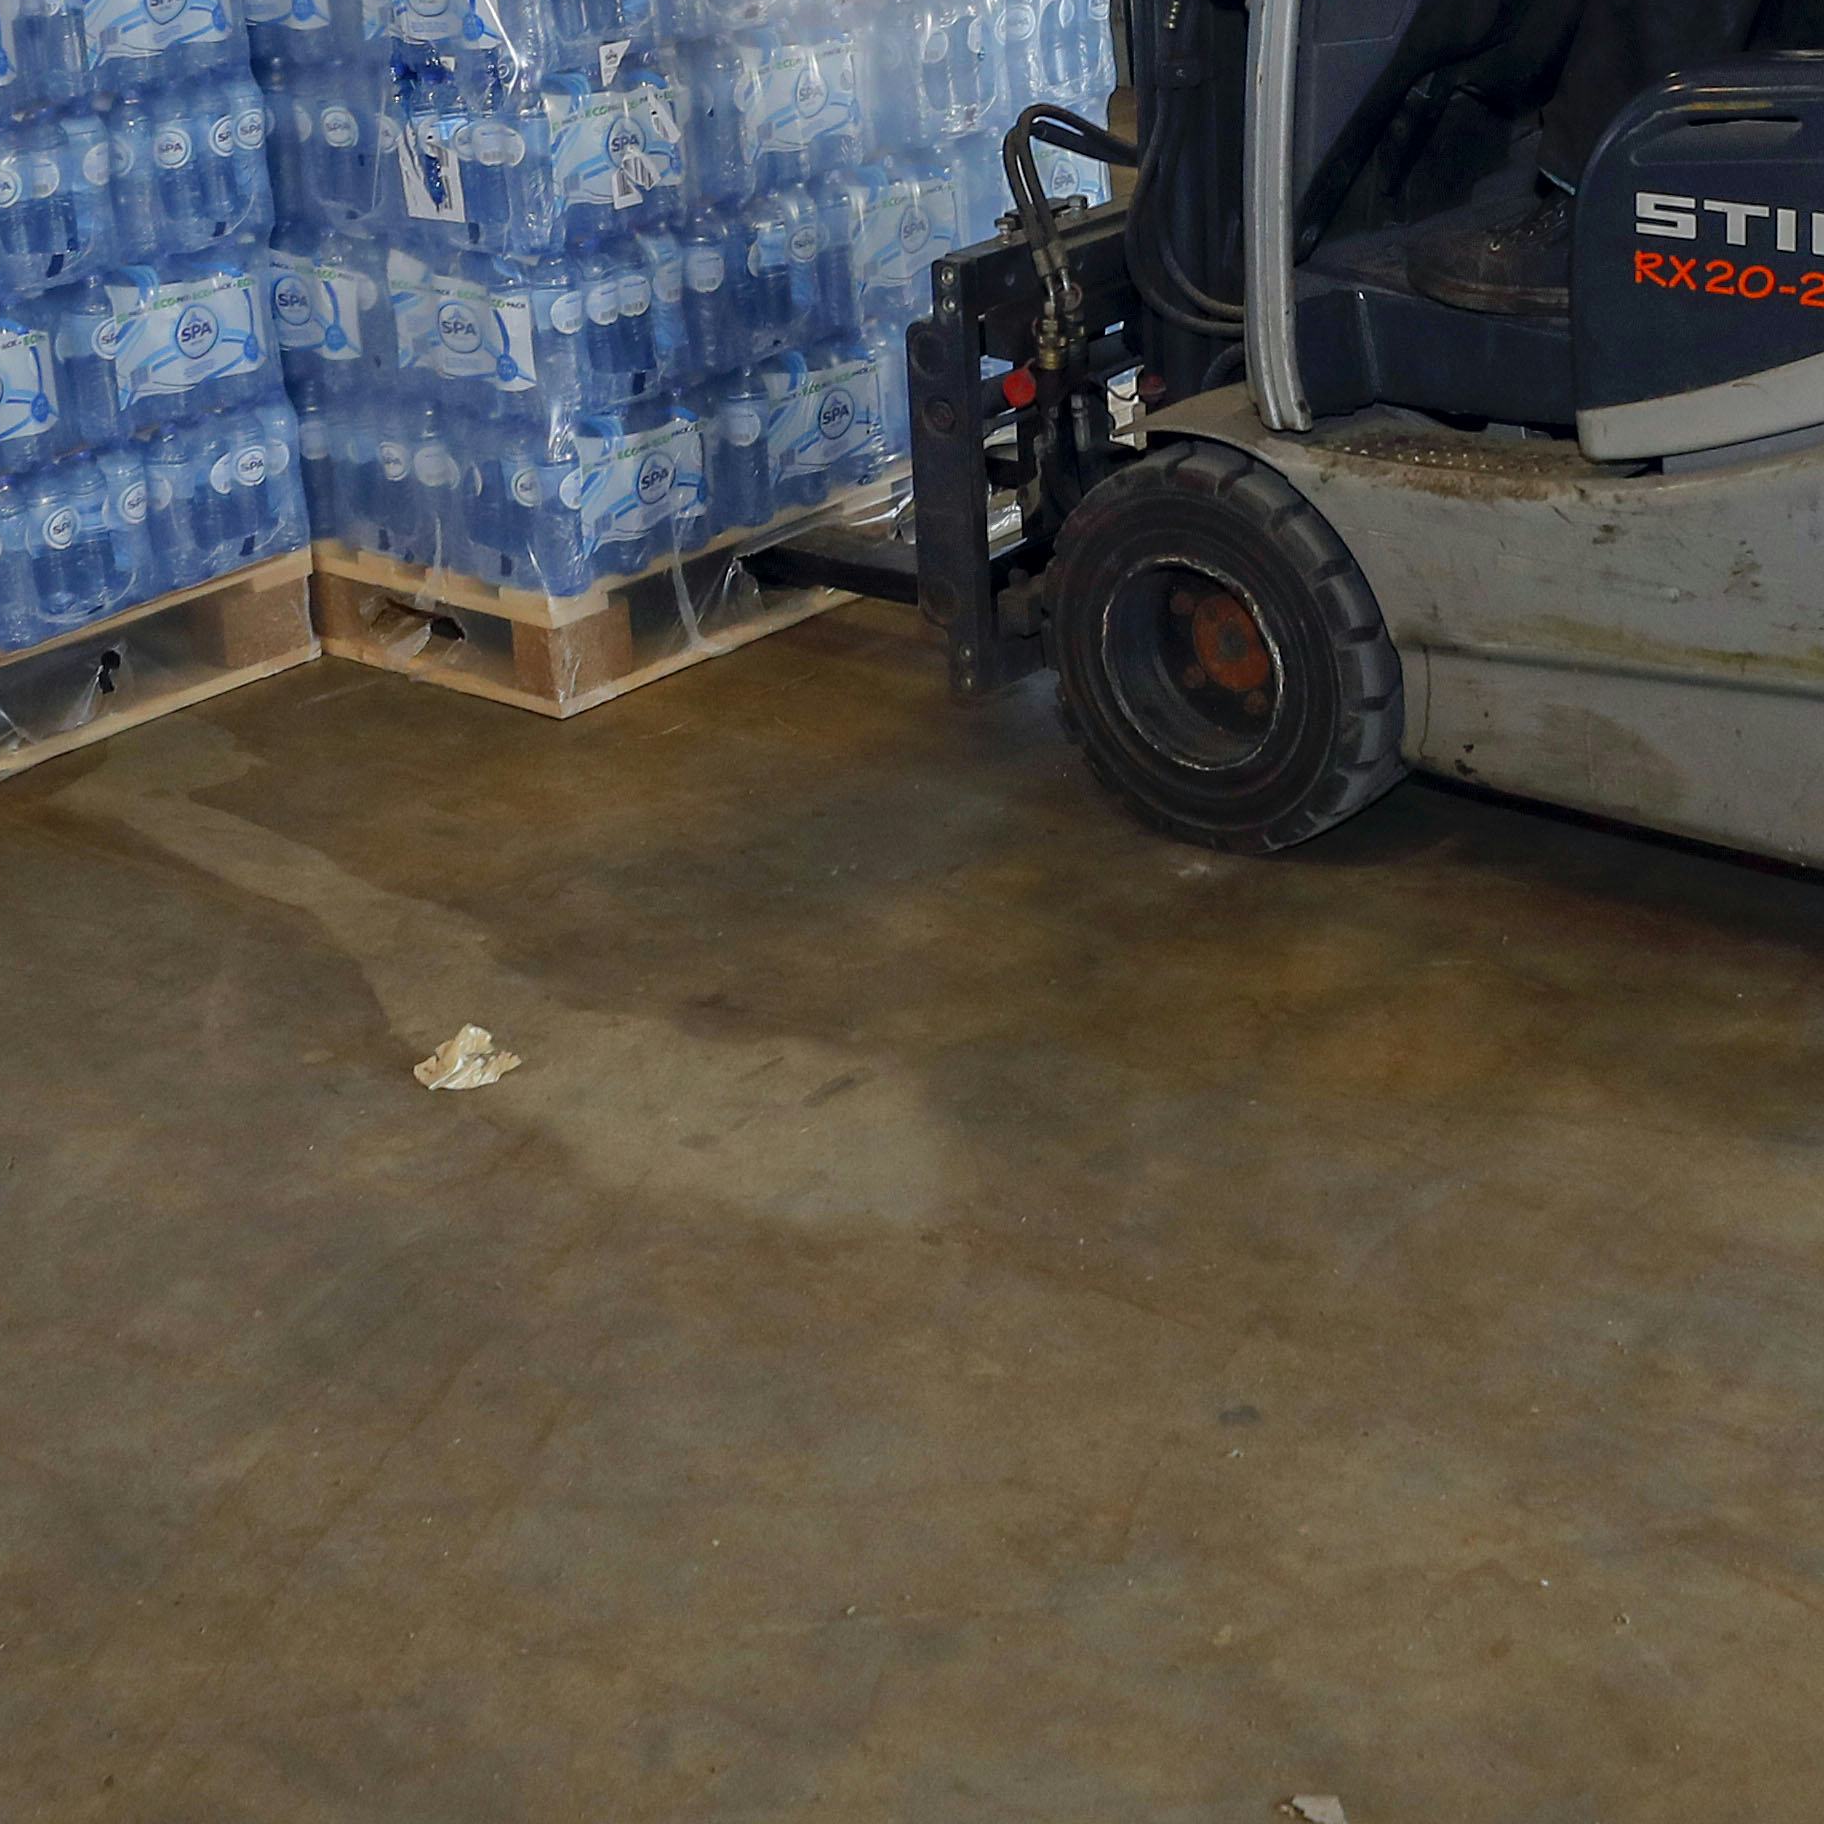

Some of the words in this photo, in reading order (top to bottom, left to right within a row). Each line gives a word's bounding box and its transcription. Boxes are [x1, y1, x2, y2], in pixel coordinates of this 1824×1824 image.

[798, 86, 823, 102] SPA
[158, 141, 183, 155] SPA
[612, 134, 639, 153] SPA
[1052, 174, 1076, 187] SPA
[902, 222, 927, 238] SPA
[278, 293, 308, 307] SPA
[181, 322, 212, 342] SPA
[442, 320, 476, 337] SPA
[822, 406, 850, 424] SPA
[640, 468, 669, 489] SPA
